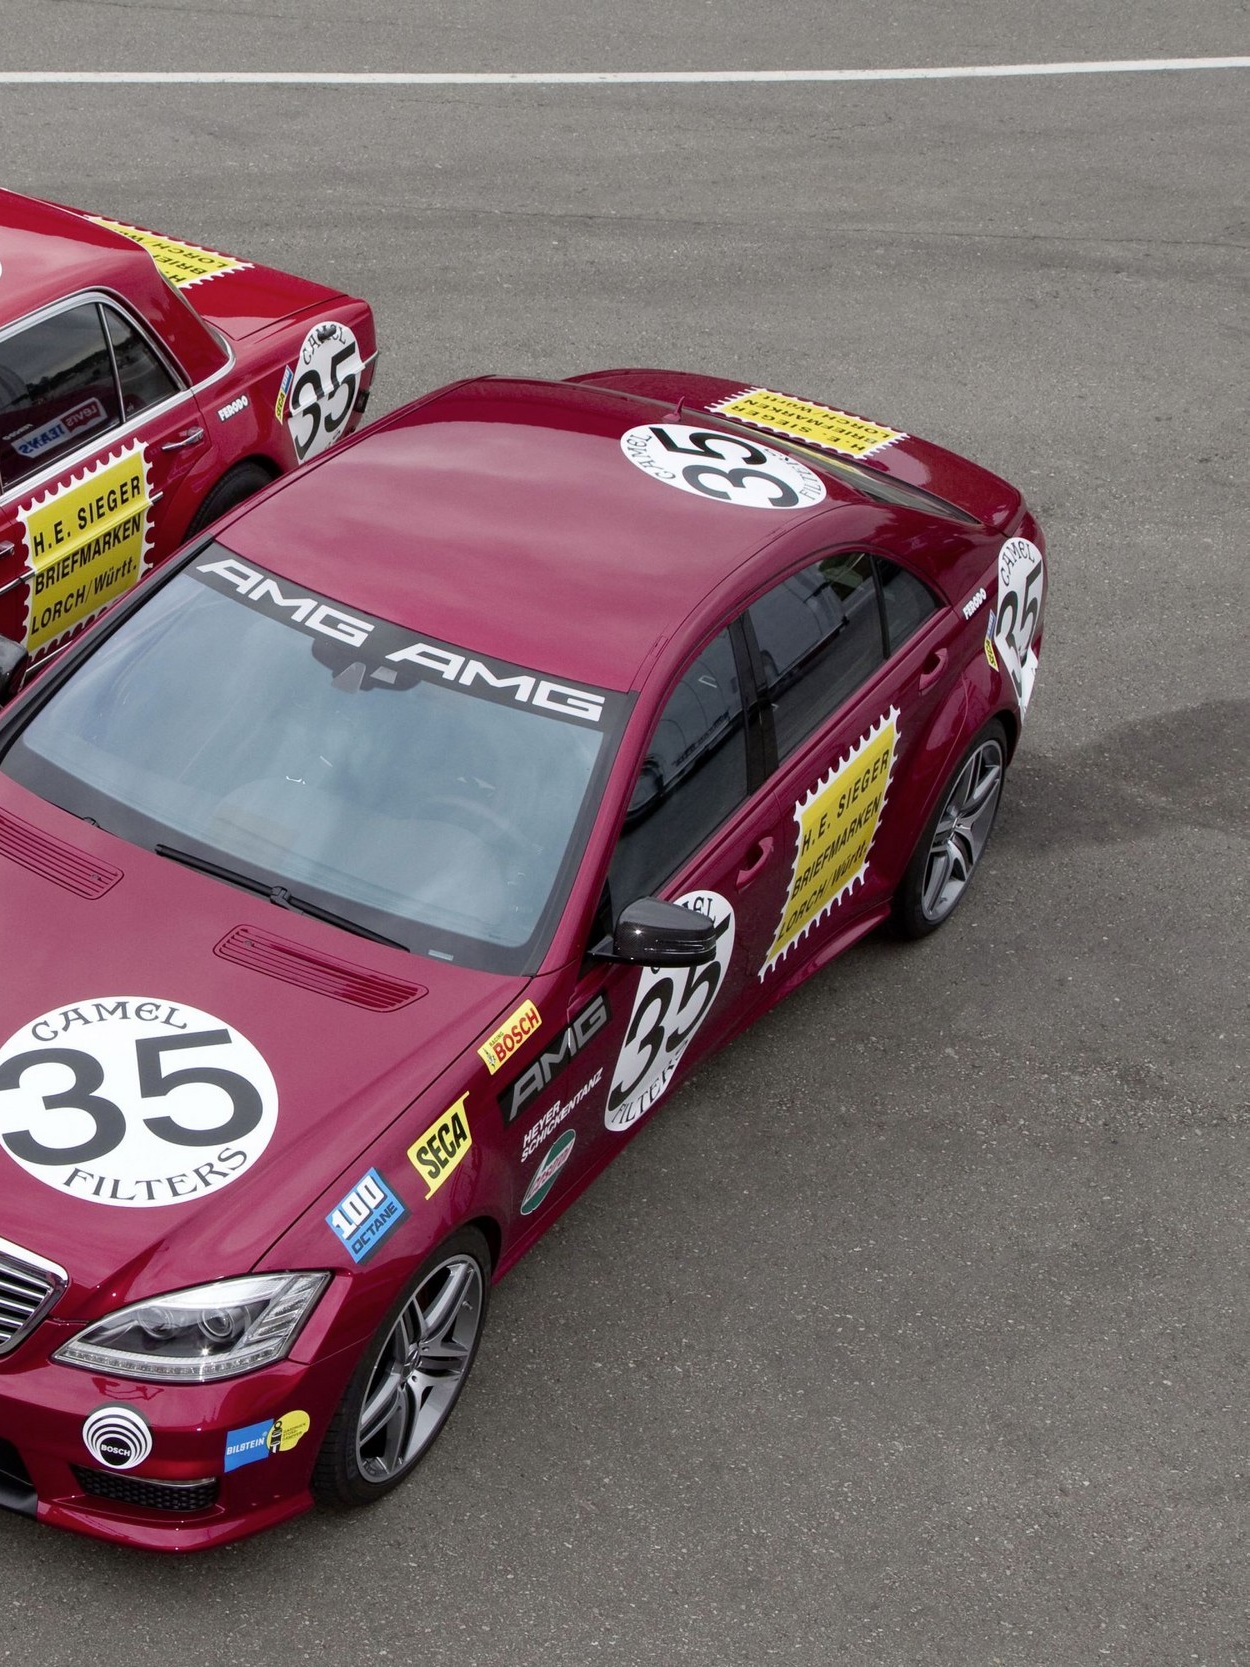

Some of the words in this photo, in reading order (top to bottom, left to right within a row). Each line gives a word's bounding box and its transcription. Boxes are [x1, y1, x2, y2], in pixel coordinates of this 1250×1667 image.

[218, 395, 248, 421] FERODO
[291, 341, 357, 460] 35
[731, 405, 812, 433] SIEGER
[744, 399, 878, 445] BRIEFMARKEN
[626, 432, 676, 481] CAMEL
[648, 427, 800, 508] 35
[77, 475, 141, 530] SIEGER
[35, 513, 141, 595] BRIEFMARKEN
[1000, 541, 1036, 587] CAMEL
[962, 588, 987, 620] FERODO
[996, 559, 1042, 698] 35
[196, 558, 375, 648] AMG
[385, 642, 606, 722] AMG
[836, 749, 890, 818] SIEGER
[791, 792, 883, 900] BRIEFMARKEN
[31, 1001, 188, 1042] CAMEL
[493, 1007, 540, 1062] BOSCH
[607, 912, 732, 1112] 35
[509, 995, 607, 1121] AMG
[611, 1039, 689, 1124] FILTERS
[520, 1067, 604, 1163] SCHICKENTANZ
[522, 1100, 561, 1149] HEYER
[416, 1112, 468, 1180] SECA
[62, 1147, 248, 1201] FILTERS
[331, 1174, 386, 1240] 100
[351, 1201, 398, 1255] OCTANE
[101, 1443, 131, 1457] BOSCH
[226, 1436, 266, 1456] BILSTEIN
